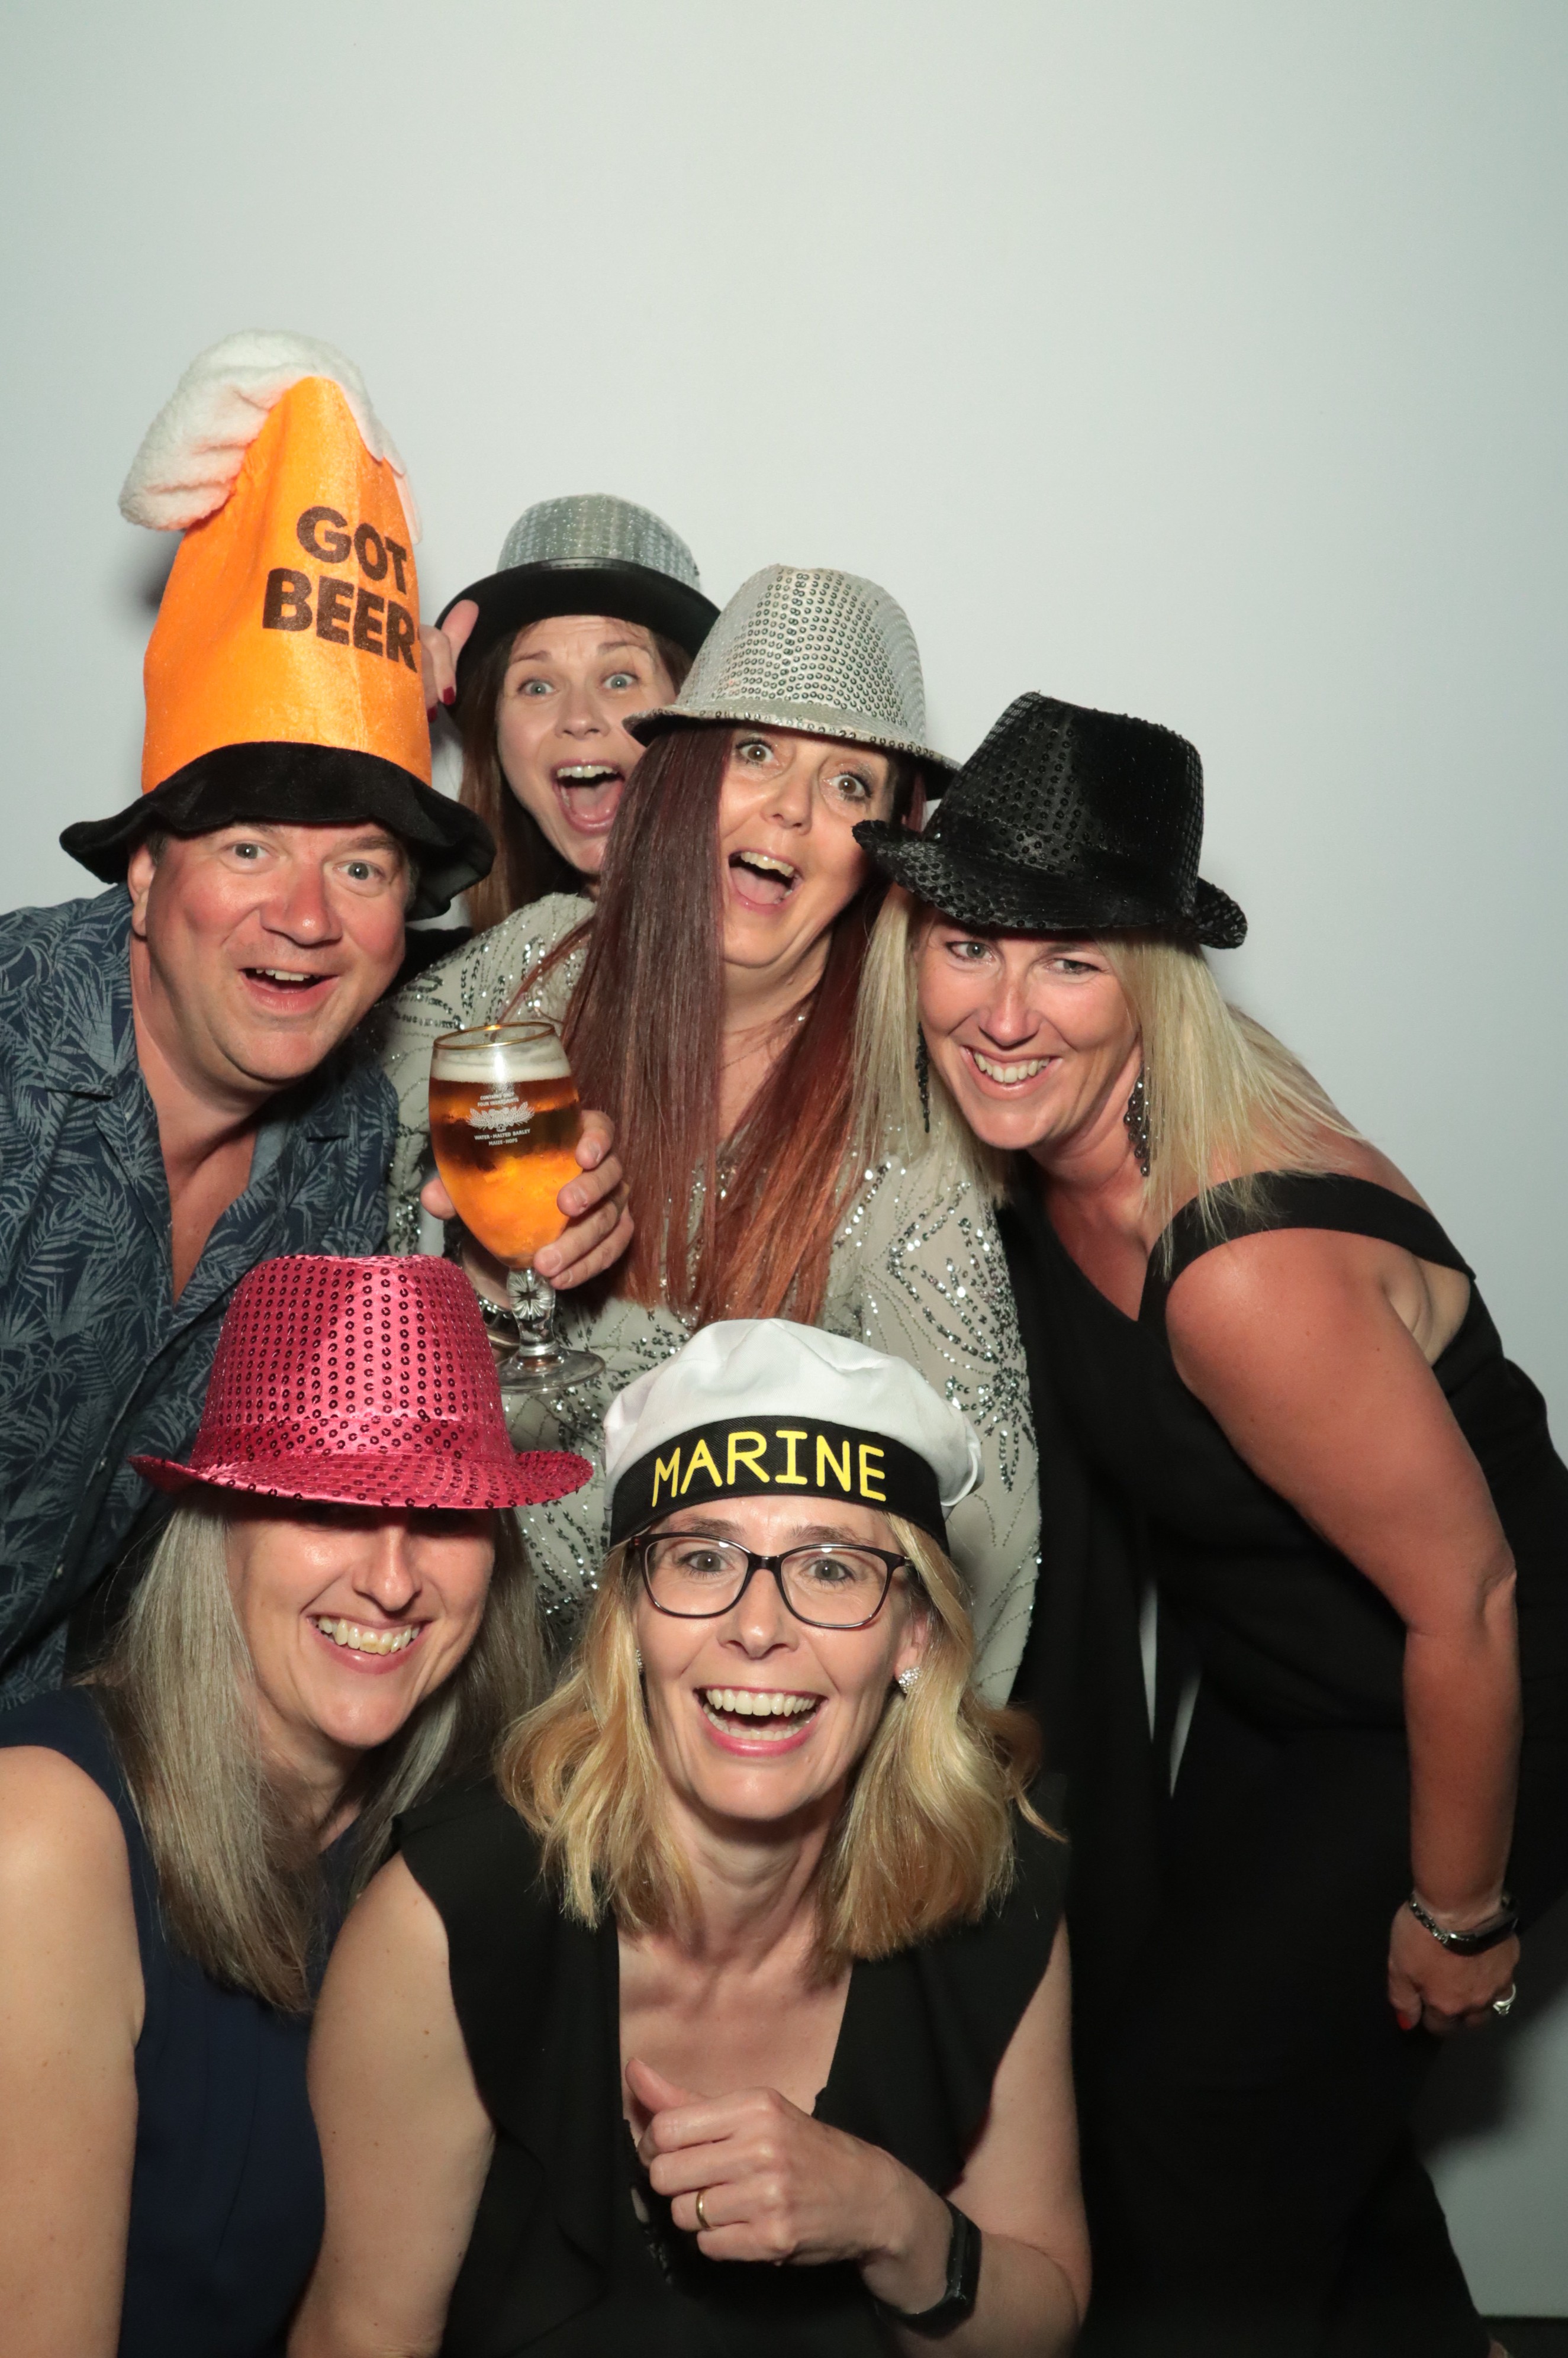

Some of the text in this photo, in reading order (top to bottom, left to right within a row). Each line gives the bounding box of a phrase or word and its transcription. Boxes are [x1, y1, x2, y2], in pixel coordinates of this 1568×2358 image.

[297, 506, 407, 595] GOT
[262, 568, 418, 674] BEER
[652, 1430, 887, 1507] MARINE
